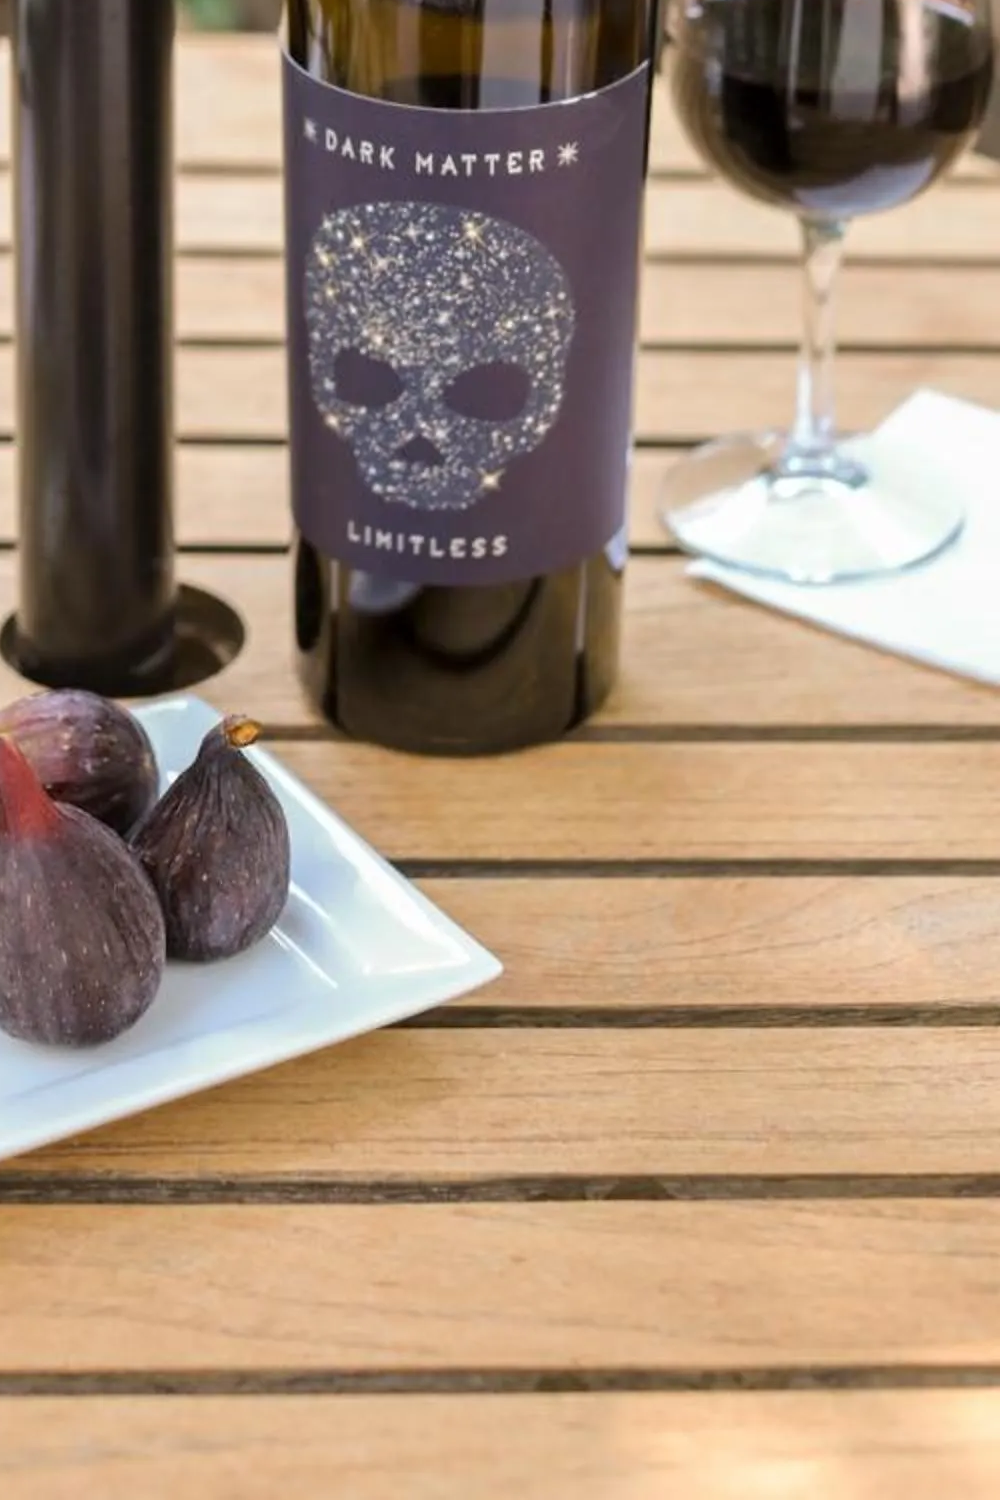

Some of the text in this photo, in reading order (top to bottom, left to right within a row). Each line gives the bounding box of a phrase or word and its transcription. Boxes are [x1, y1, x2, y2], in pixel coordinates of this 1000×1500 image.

[325, 128, 545, 176] DARK MATTER
[347, 520, 507, 558] LIMITLESS
